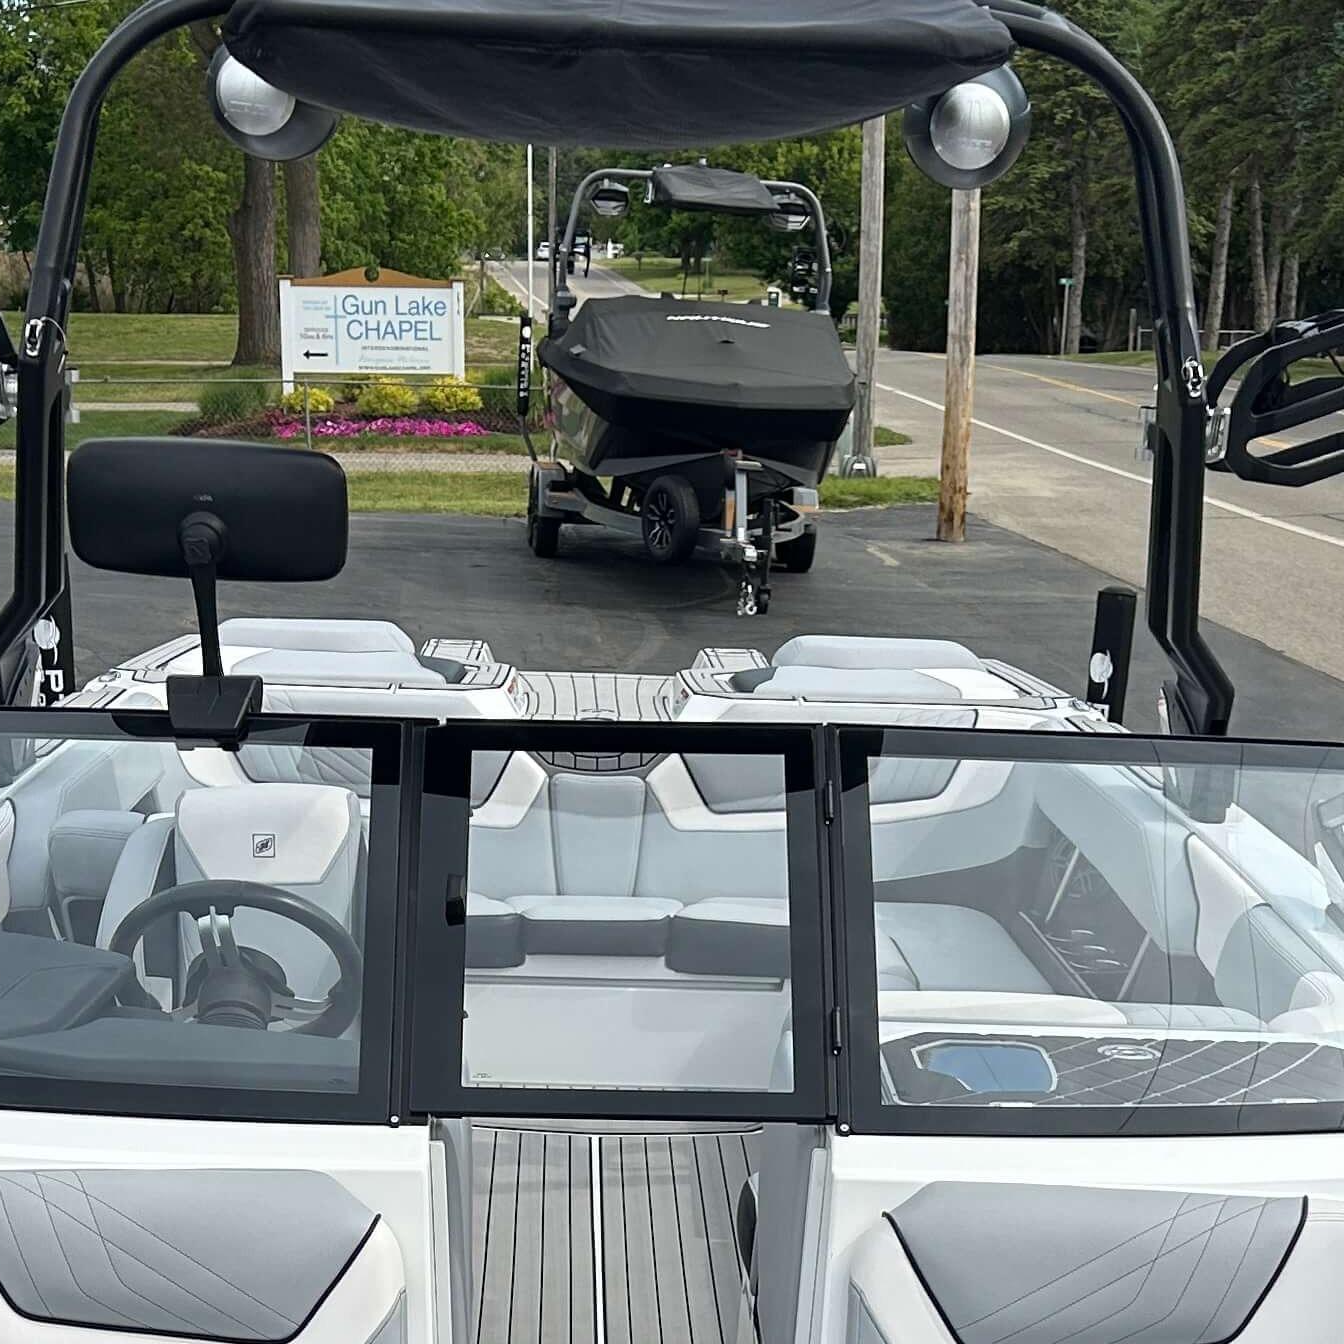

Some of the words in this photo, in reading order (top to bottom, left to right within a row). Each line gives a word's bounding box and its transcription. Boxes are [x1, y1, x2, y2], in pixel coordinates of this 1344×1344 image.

[342, 294, 386, 316] Gun
[395, 295, 447, 317] Lake
[346, 319, 442, 341] CHAPEL
